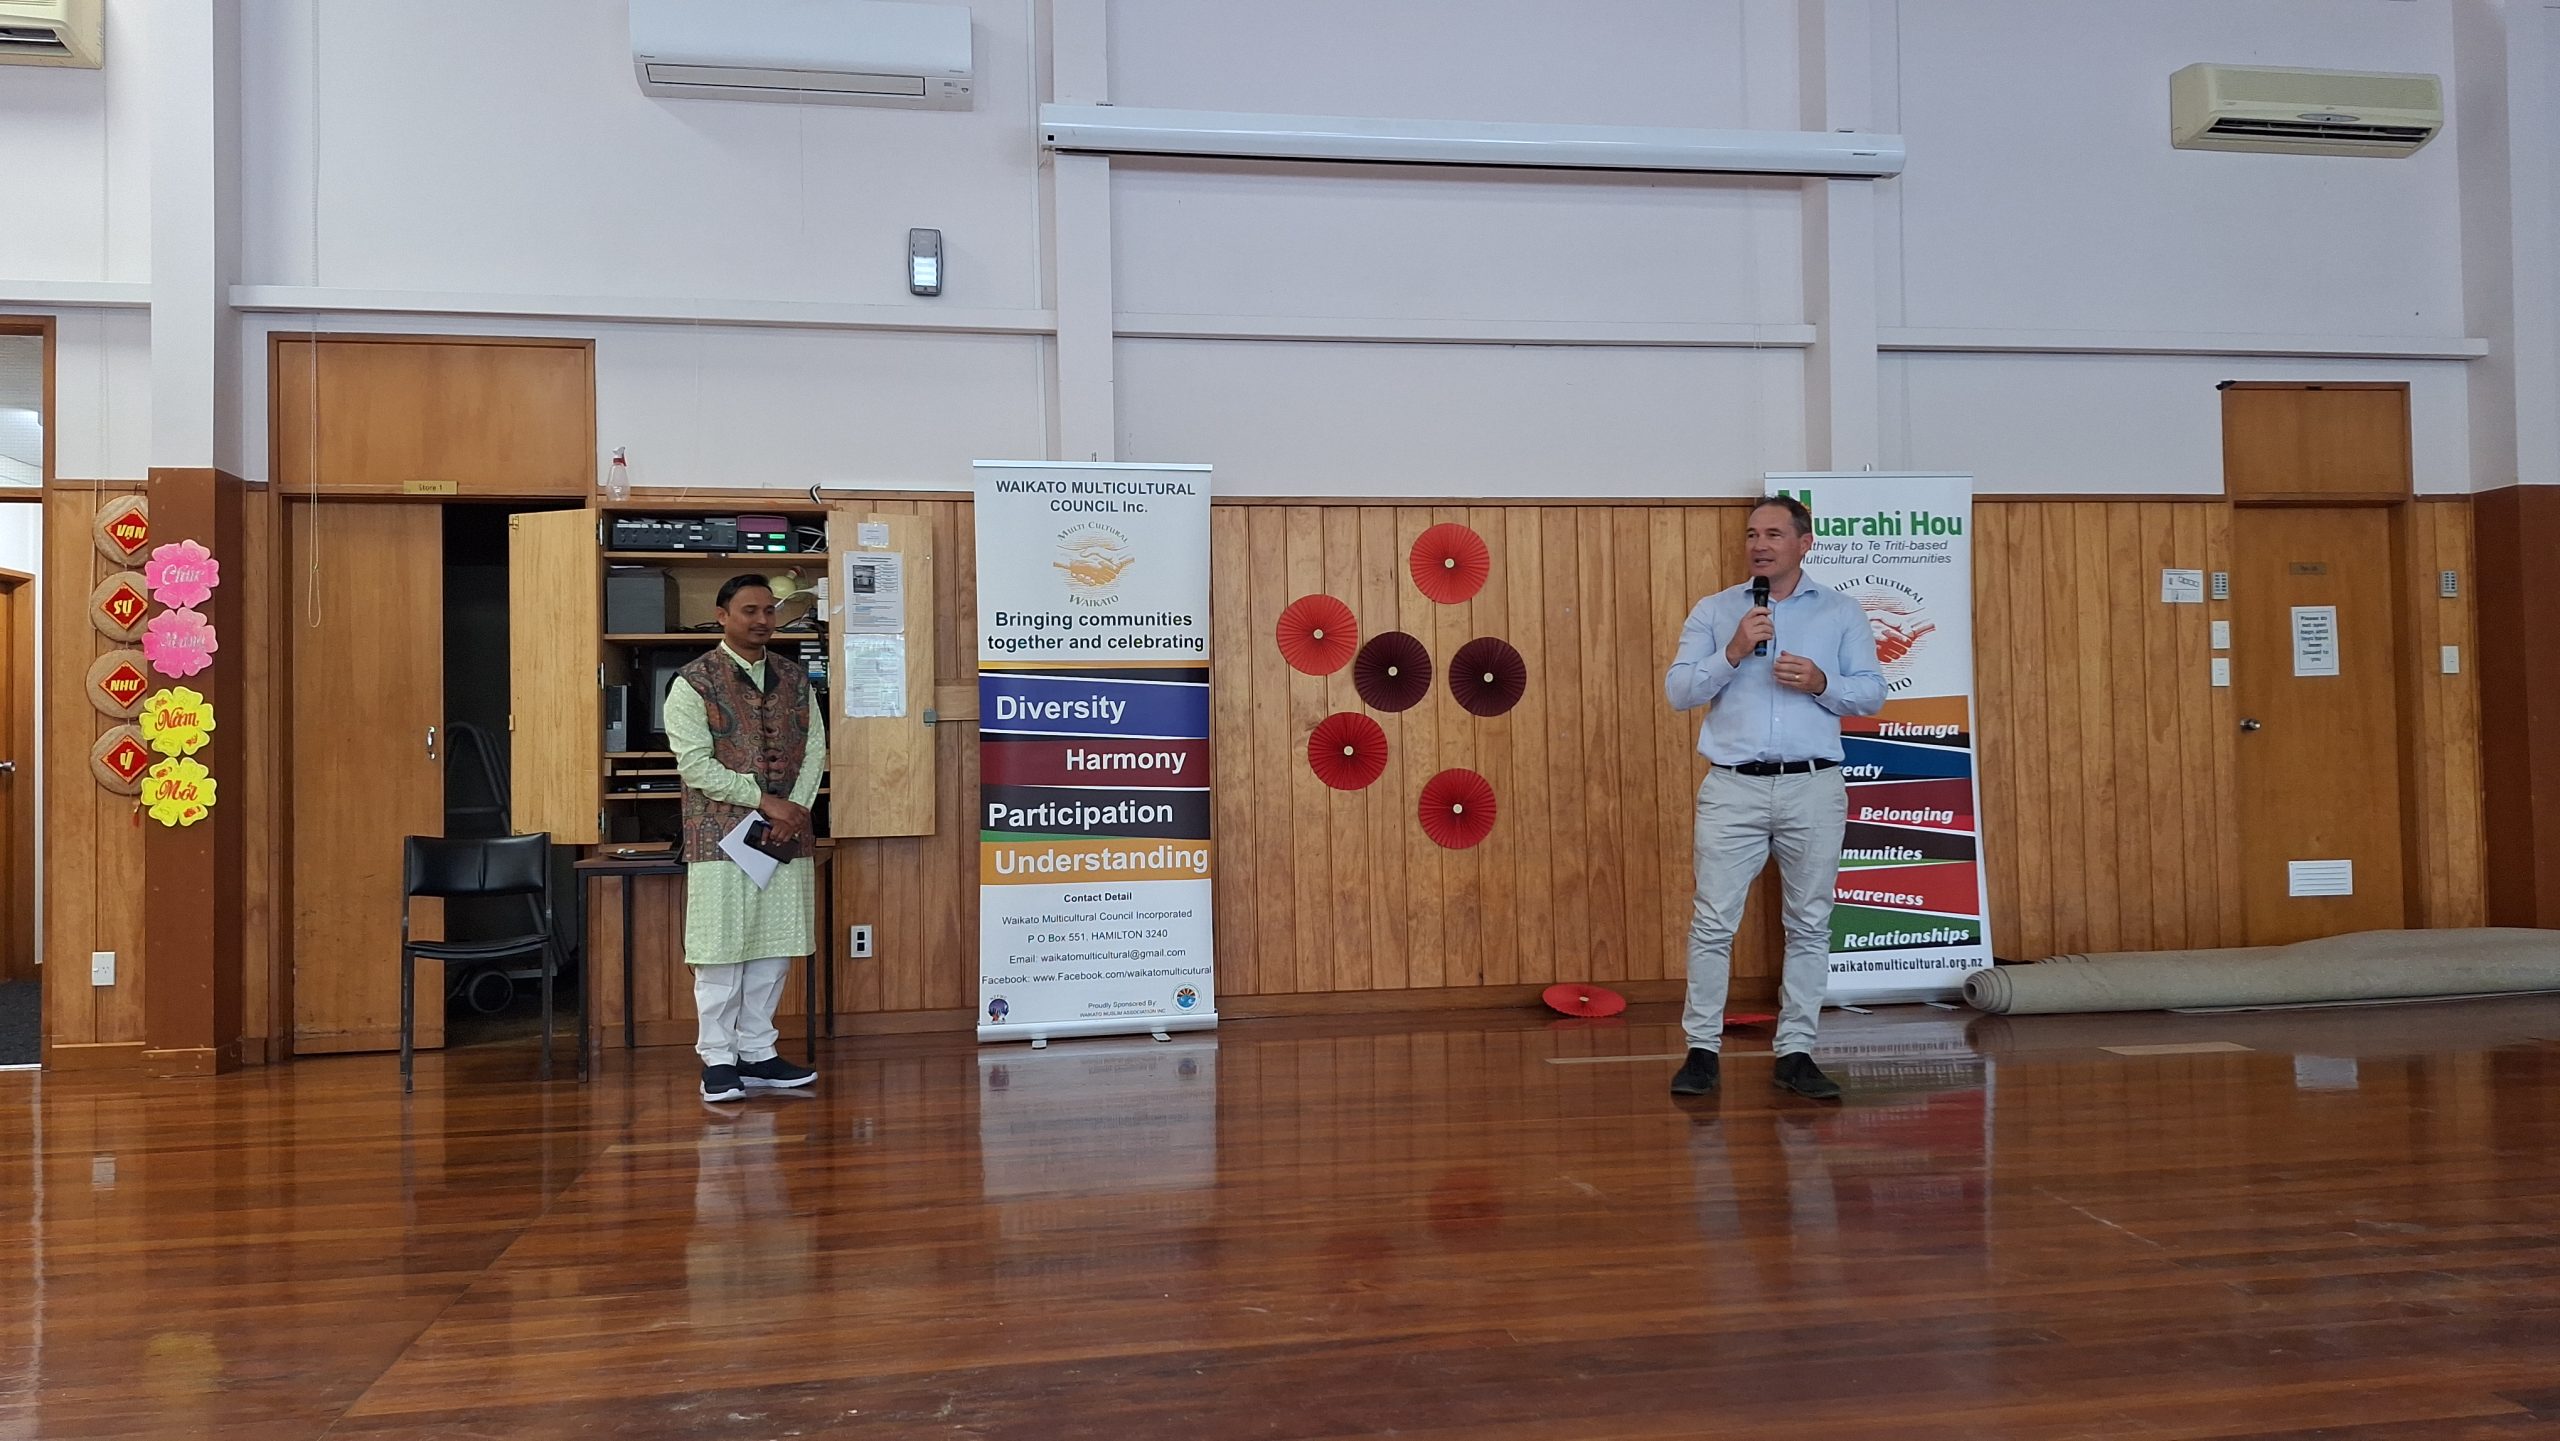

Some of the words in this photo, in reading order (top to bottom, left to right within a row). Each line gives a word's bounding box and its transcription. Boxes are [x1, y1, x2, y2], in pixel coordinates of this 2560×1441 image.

[996, 480, 1067, 494] WAIKATO
[1071, 481, 1196, 495] MULTICULTURAL
[1050, 499, 1118, 513] COUNCIL
[1123, 501, 1148, 513] Inc.
[1910, 511, 1962, 536] Hou
[116, 524, 146, 540] VẠN
[1809, 541, 1847, 553] thway
[1851, 541, 1863, 551] to
[1868, 541, 1880, 551] Te
[1885, 541, 1948, 551] Triti-based
[1872, 553, 1951, 565] Communities
[1834, 578, 1860, 592] ULTI
[995, 612, 1073, 629] Bringing
[1078, 612, 1193, 627] communities
[988, 635, 1064, 652] together
[1069, 635, 1101, 649] and
[1107, 635, 1204, 651] celebrating
[996, 695, 1126, 724] Diversity
[1878, 721, 1960, 738] Tikianga
[1066, 748, 1187, 774] Harmony
[1840, 763, 1884, 779] eaty
[988, 800, 1173, 830] Participation
[1860, 806, 1954, 824] Belonging
[995, 845, 1208, 874] Understanding
[1840, 845, 1923, 860] munities
[1064, 893, 1102, 903] Contact
[1105, 892, 1132, 901] Detail
[1002, 916, 1040, 925] Waikato
[1042, 913, 1097, 923] Multicultural
[1099, 911, 1134, 921] Council
[1136, 910, 1193, 920] Incorporated
[1028, 935, 1035, 943] P
[1037, 934, 1046, 943] O
[1048, 933, 1066, 943] Box
[1091, 930, 1143, 940] HAMILTON
[1145, 929, 1168, 938] 3240
[1844, 928, 1970, 948] Relationships
[1009, 955, 1038, 964] Email:
[1040, 948, 1186, 963] waikatomulticultural@gmail.com
[1828, 957, 1983, 973] .waikatomulticultural.org.nz
[982, 974, 1031, 984] Facebook:
[1088, 1002, 1111, 1010] Proudly
